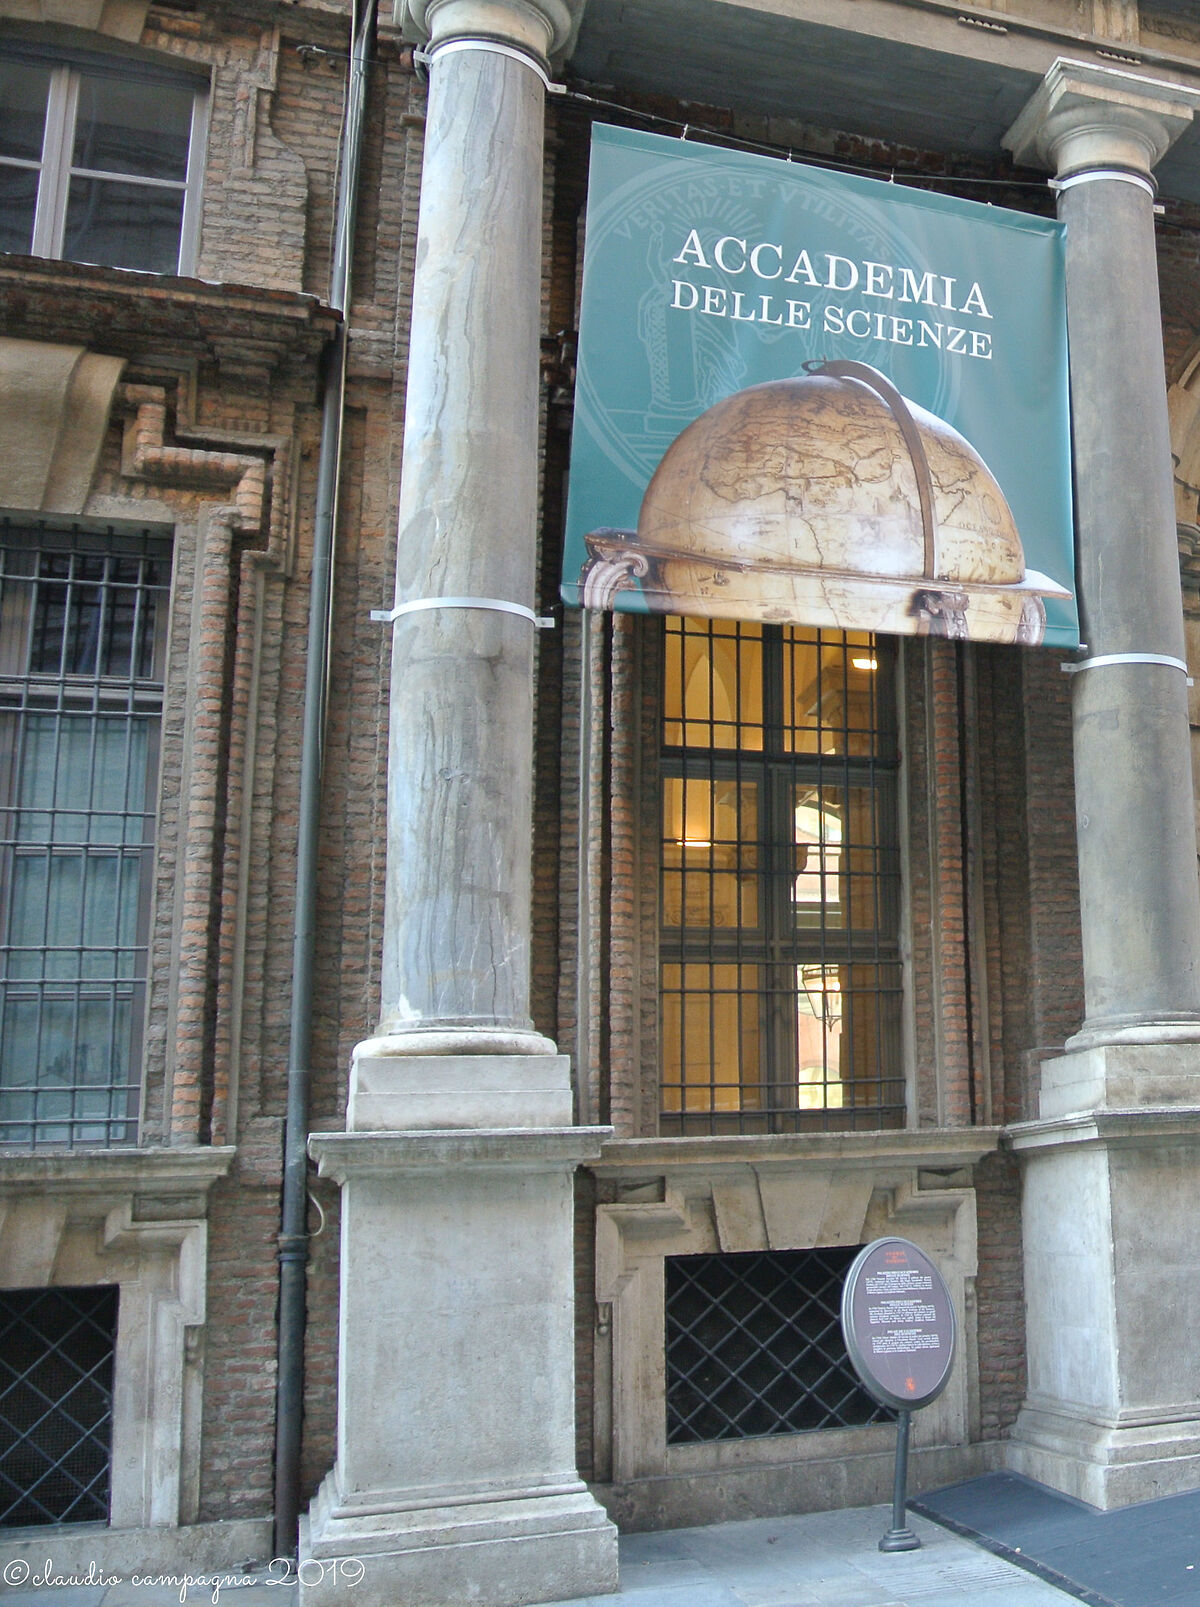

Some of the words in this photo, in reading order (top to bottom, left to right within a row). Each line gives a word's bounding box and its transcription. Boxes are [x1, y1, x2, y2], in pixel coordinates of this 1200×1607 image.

[612, 176, 718, 240] VERITAS
[728, 177, 767, 198] ET
[673, 229, 993, 319] ACCADEMIA
[670, 279, 811, 329] DELLE
[823, 305, 993, 360] SCIENZE
